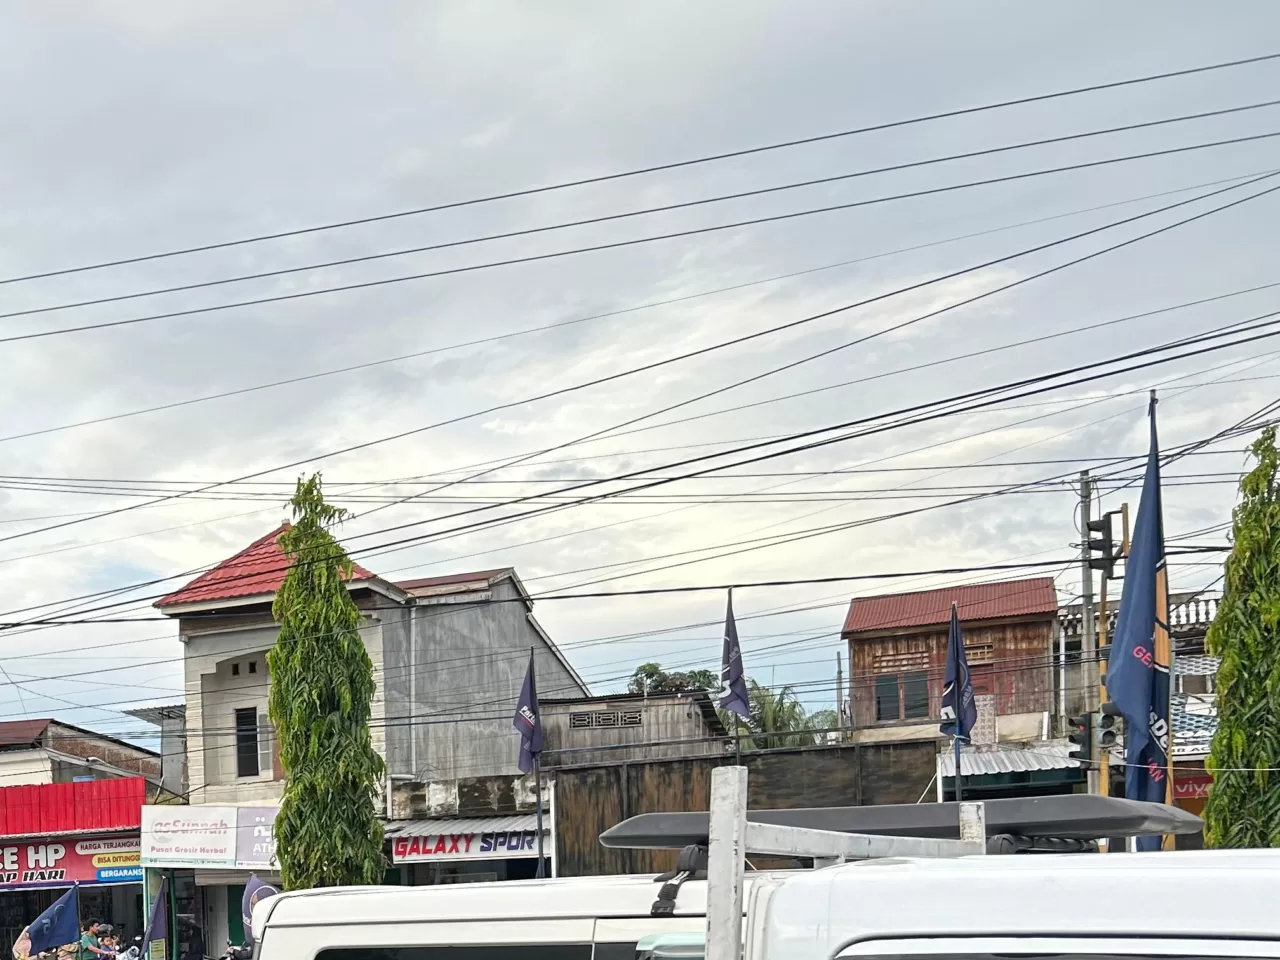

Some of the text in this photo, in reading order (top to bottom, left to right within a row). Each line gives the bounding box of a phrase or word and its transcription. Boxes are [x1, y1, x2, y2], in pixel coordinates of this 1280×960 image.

[80, 842, 102, 850] HARGA
[199, 846, 227, 854] Herbal
[394, 832, 476, 859] GALAXY
[26, 843, 66, 869] HP
[22, 868, 67, 883] HARI
